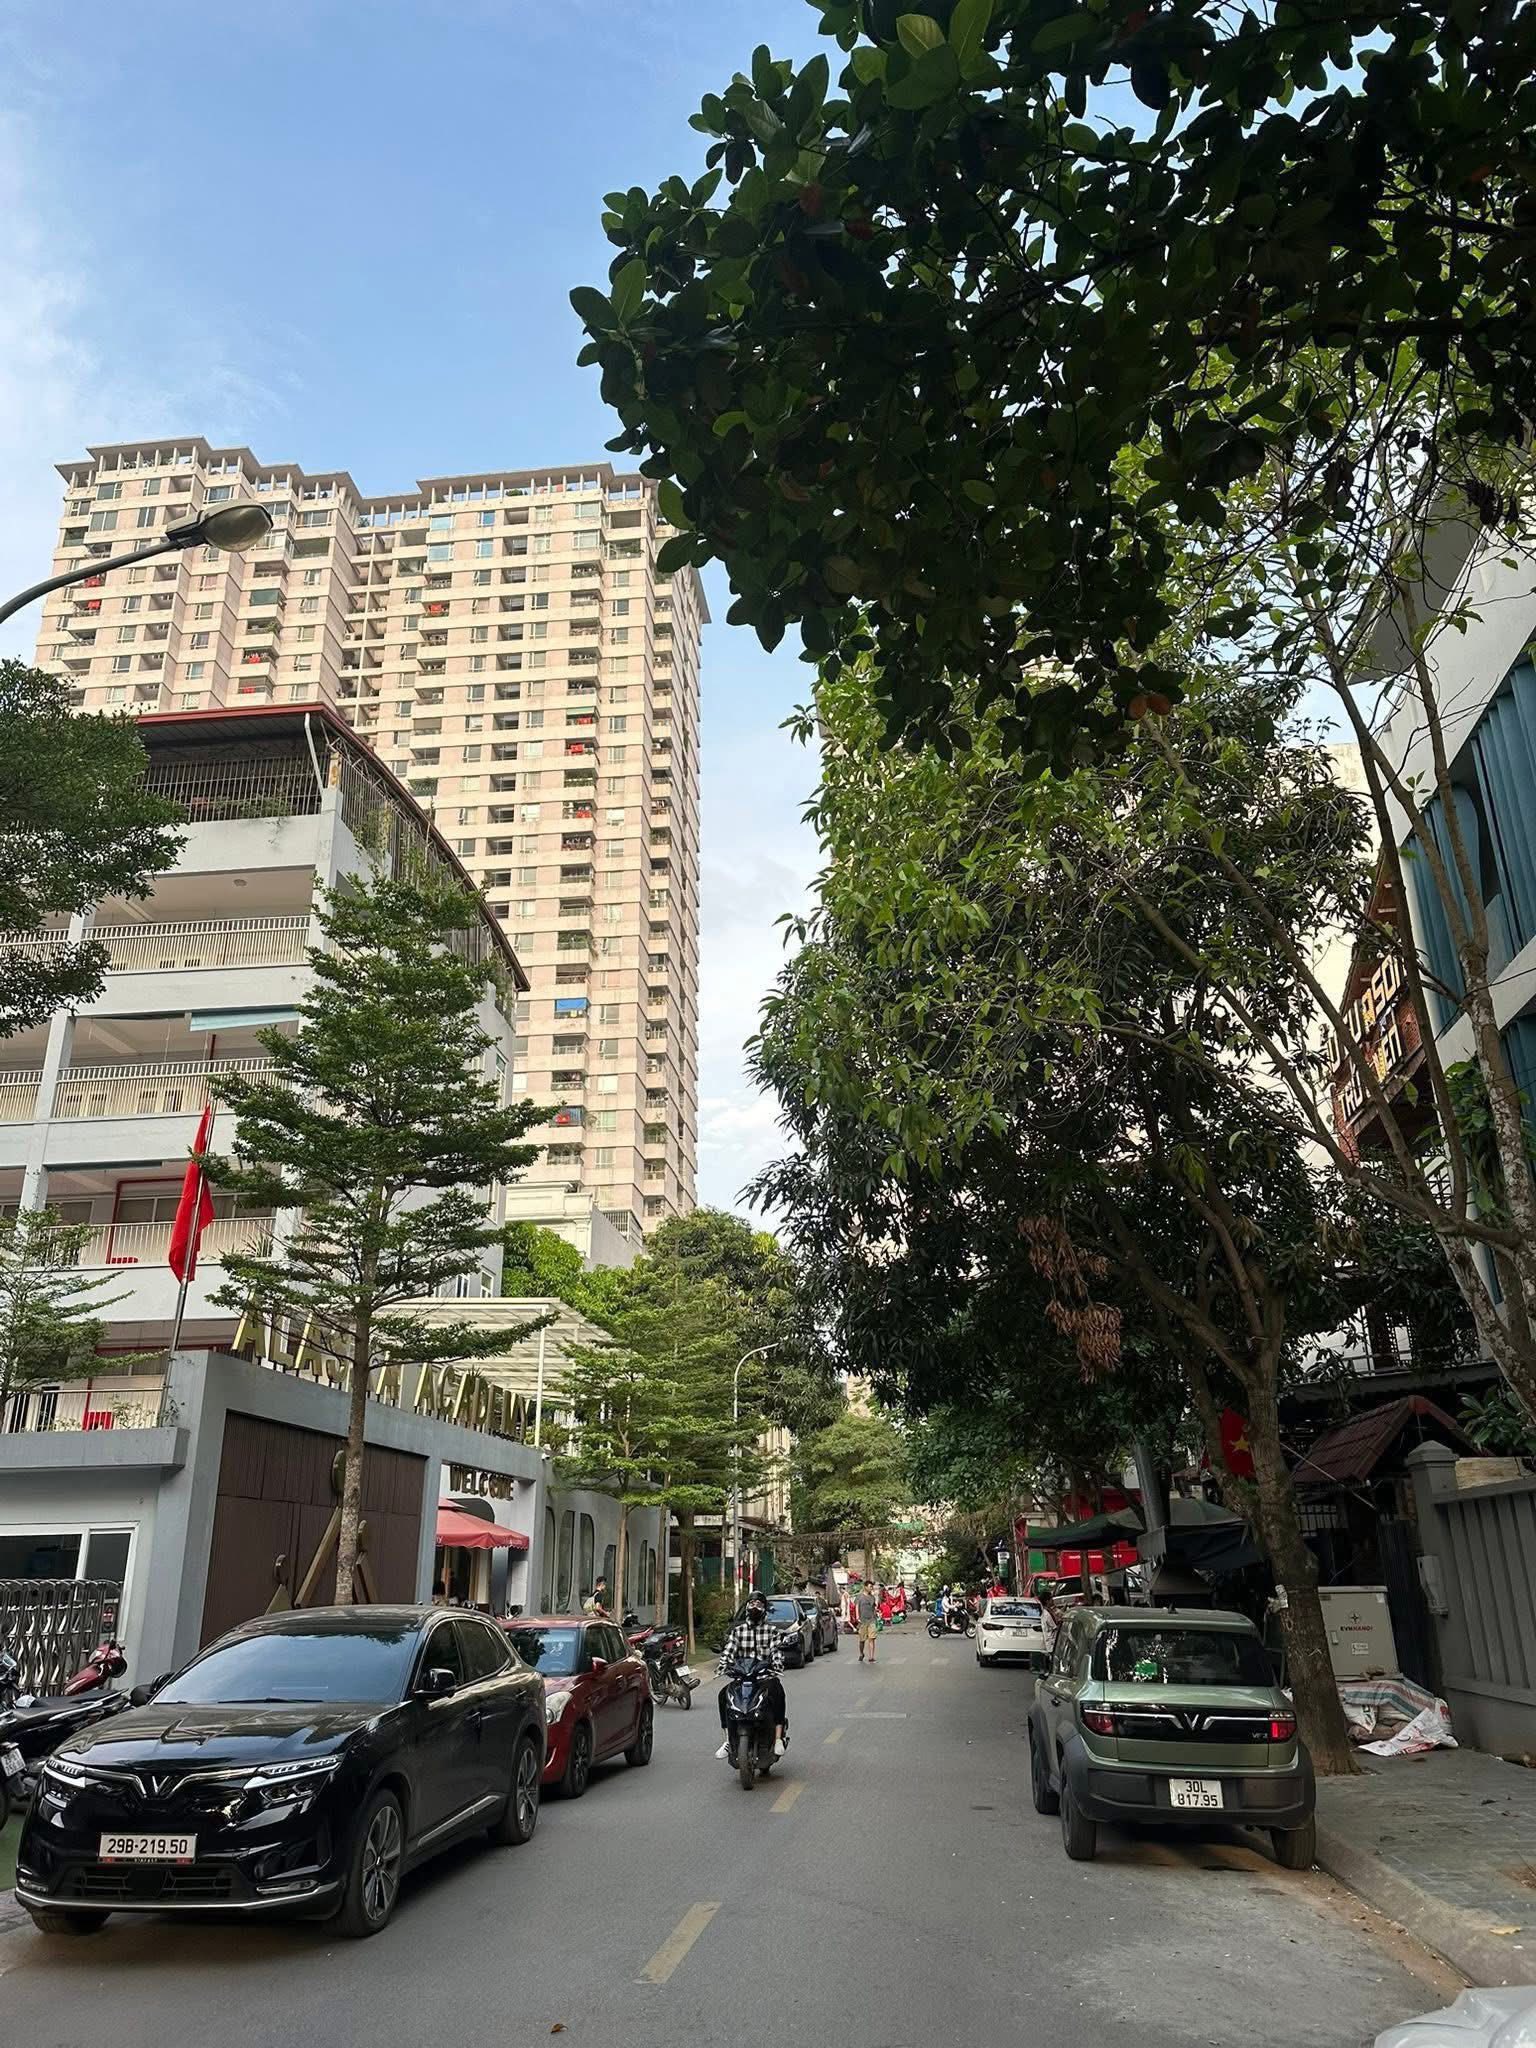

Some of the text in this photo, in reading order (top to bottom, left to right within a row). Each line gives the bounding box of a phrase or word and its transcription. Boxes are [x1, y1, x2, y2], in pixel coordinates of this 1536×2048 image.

[231, 1288, 398, 1401] ALASA
[449, 1464, 514, 1501] WELCOME
[1185, 1781, 1207, 1793] 30L
[1178, 1794, 1218, 1807] 817.95
[107, 1838, 188, 1854] 29B-219.50
